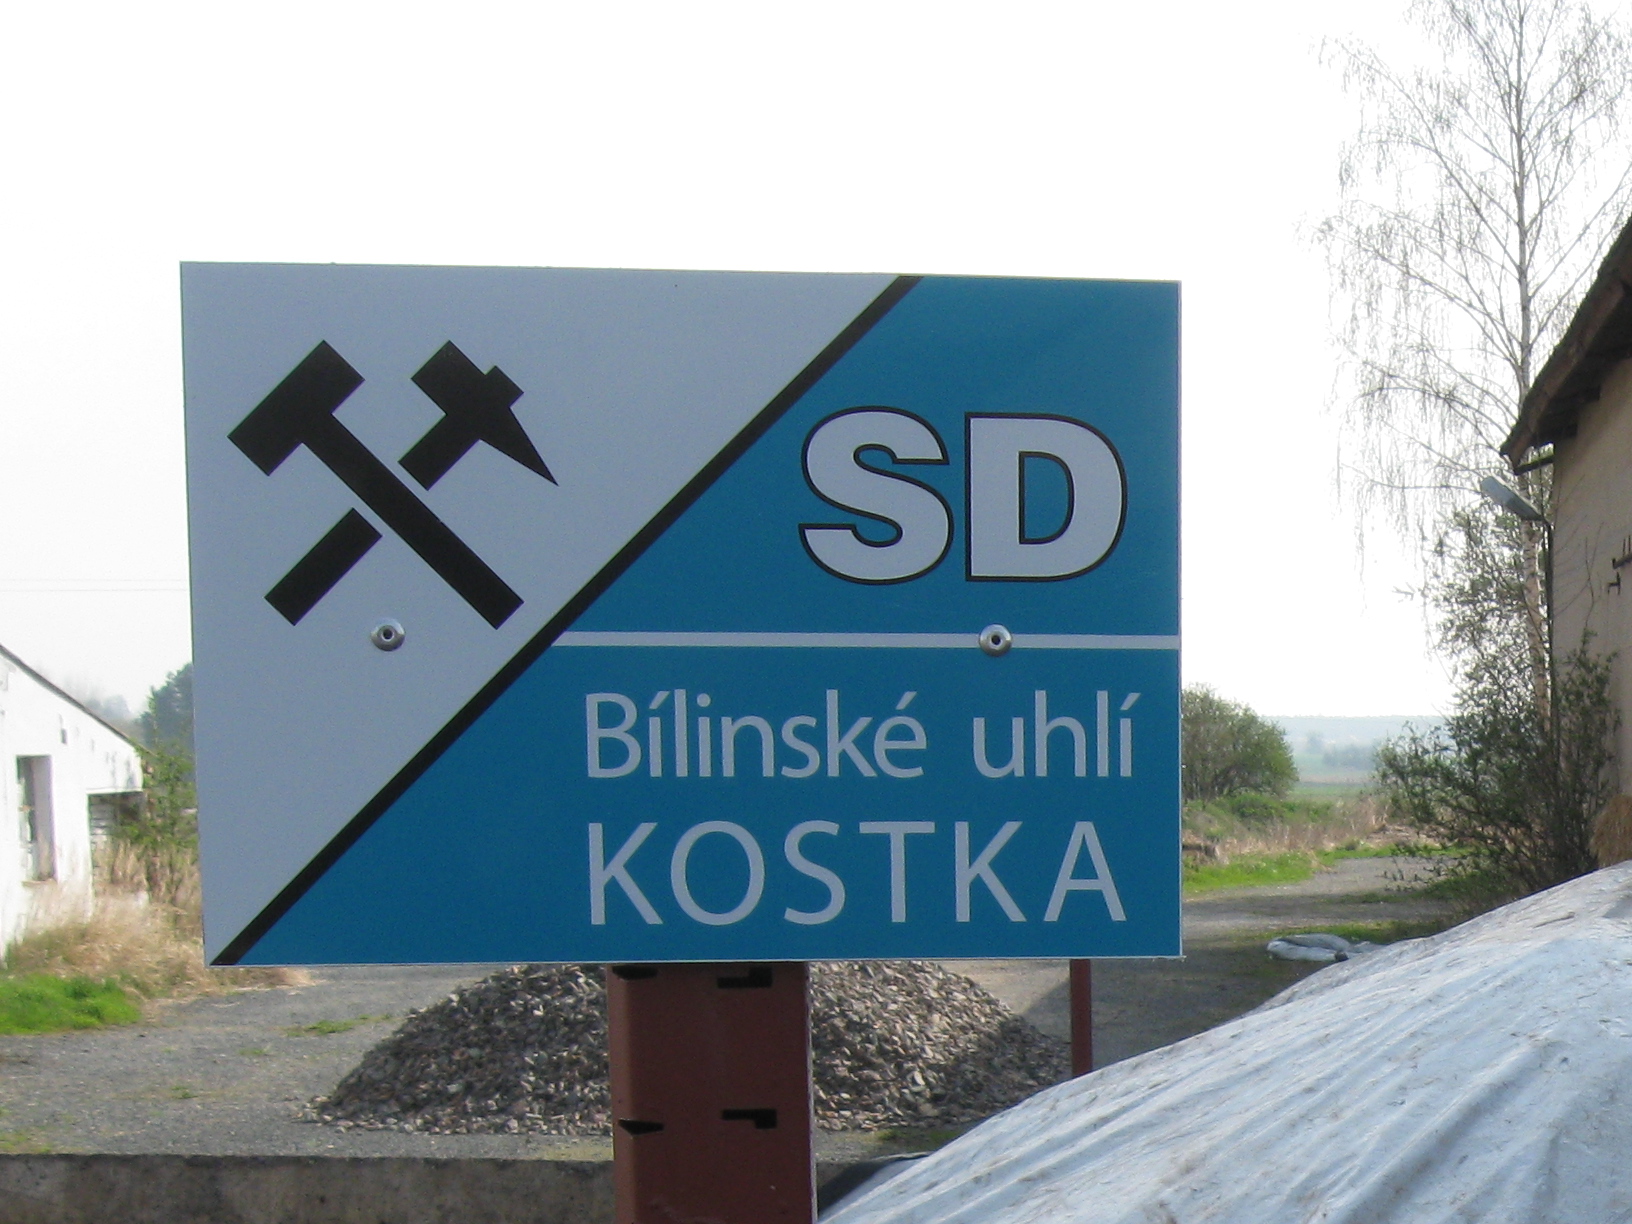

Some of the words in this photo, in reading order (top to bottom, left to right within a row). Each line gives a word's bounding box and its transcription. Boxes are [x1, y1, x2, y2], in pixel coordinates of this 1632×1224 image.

[800, 406, 1127, 585] SD
[586, 689, 927, 779] Bílinské
[973, 690, 1140, 779] uhlí
[588, 820, 1127, 926] KOSTKA
